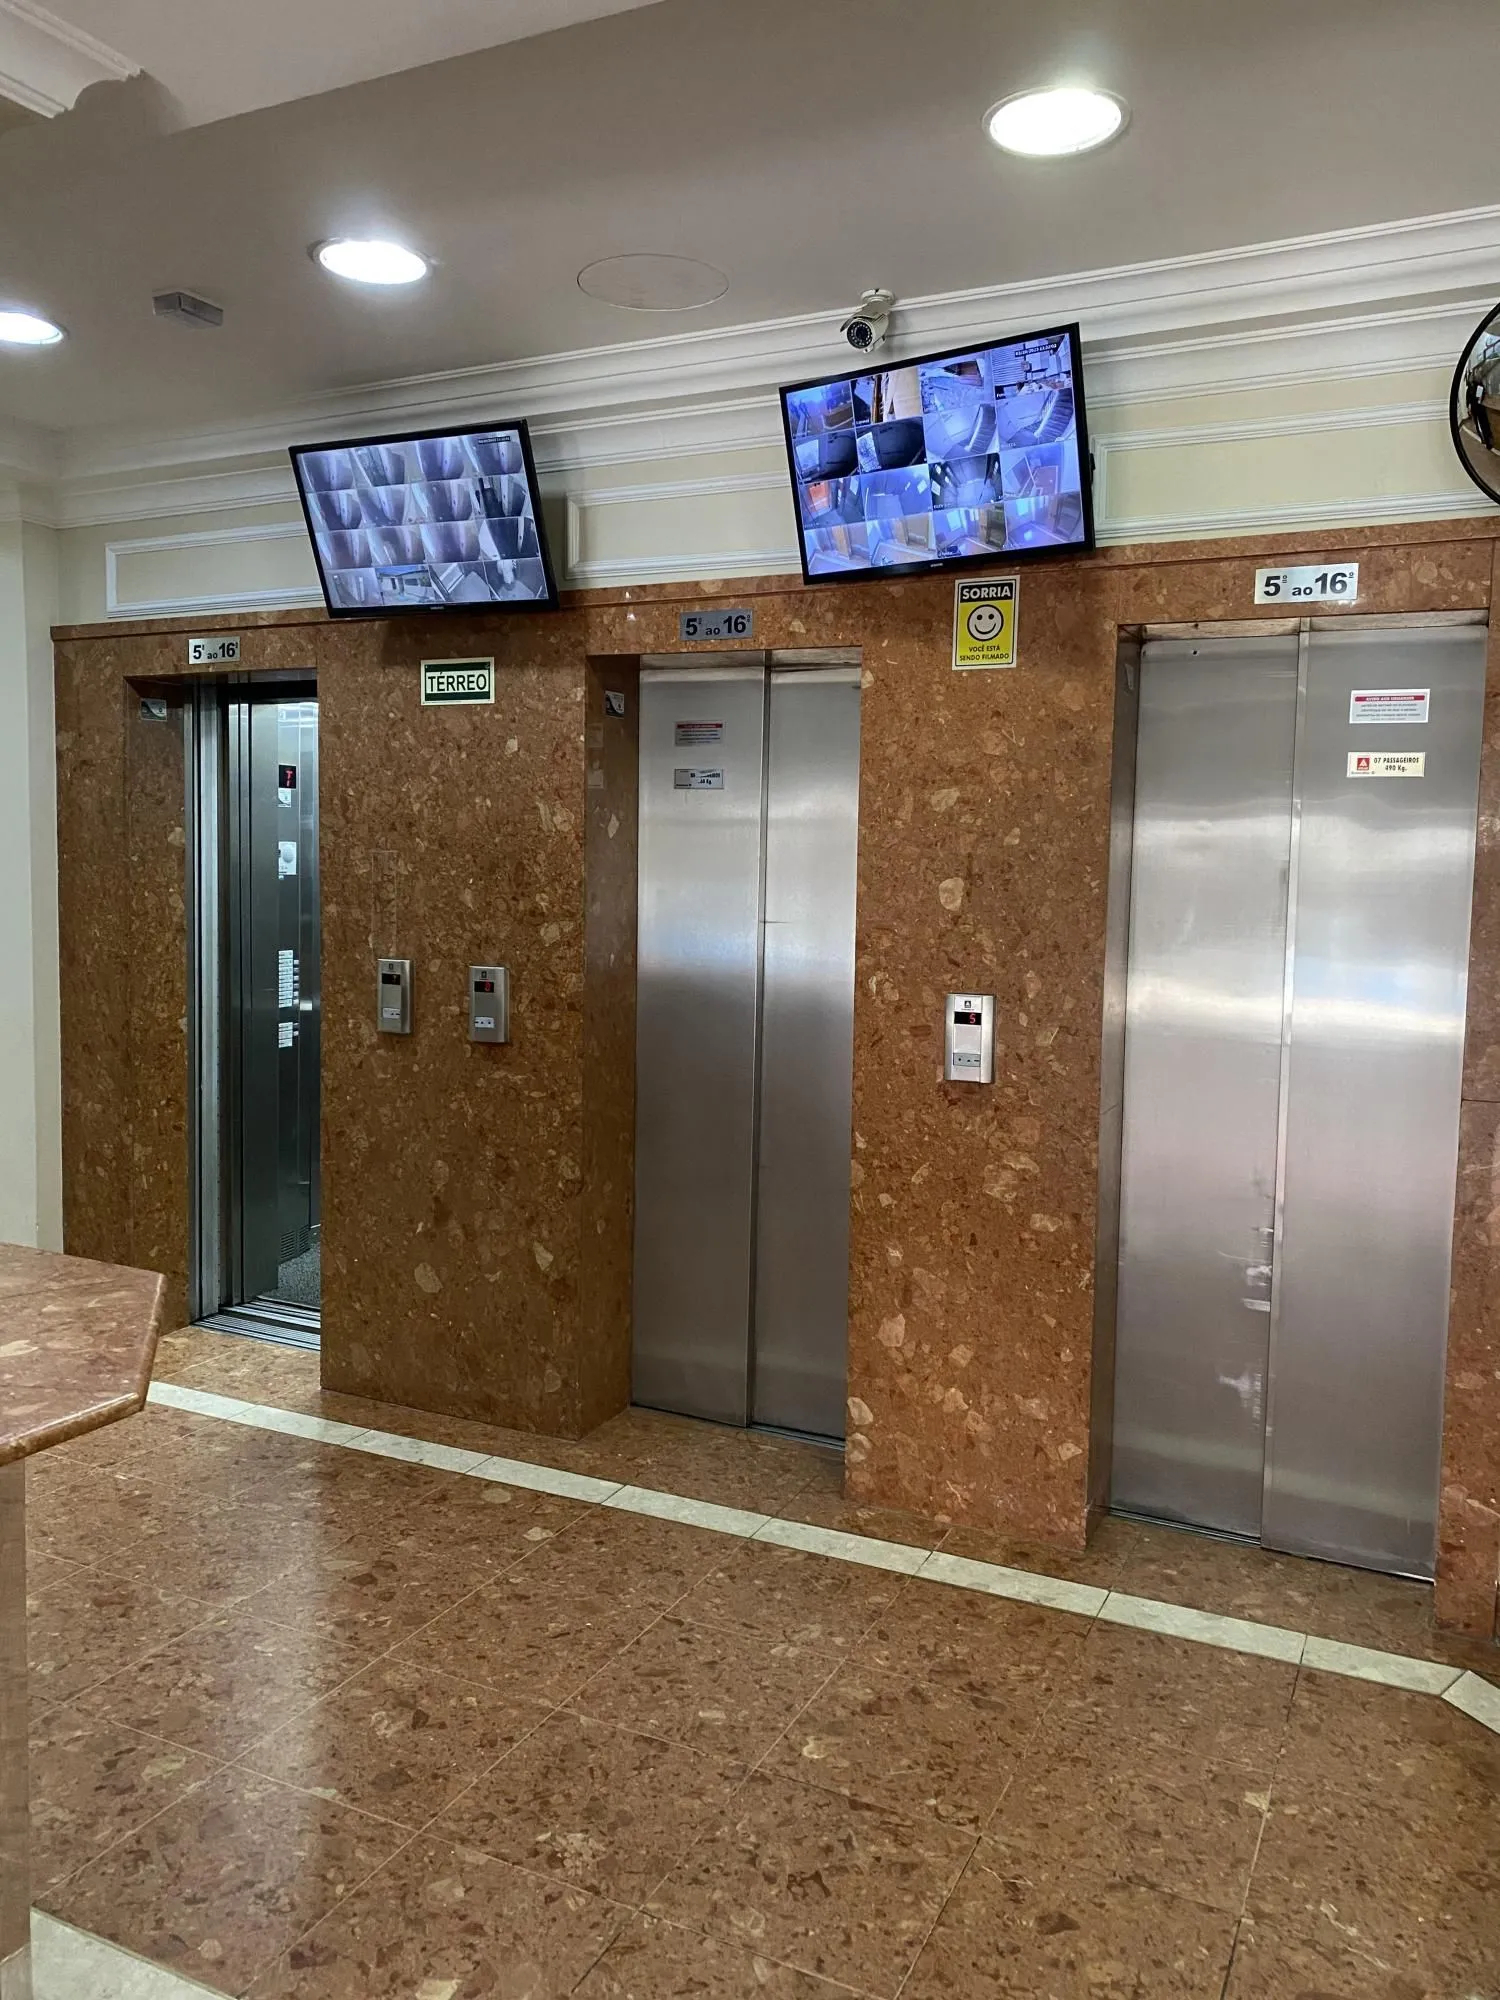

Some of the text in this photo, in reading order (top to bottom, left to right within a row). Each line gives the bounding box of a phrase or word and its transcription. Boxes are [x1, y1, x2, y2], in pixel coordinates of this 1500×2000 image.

[962, 585, 1011, 600] SORRIA
[1291, 586, 1313, 596] ao
[705, 627, 721, 636] ao
[986, 644, 1000, 652] ESTÁ
[207, 652, 218, 660] ao
[427, 671, 487, 692] TÉRREO
